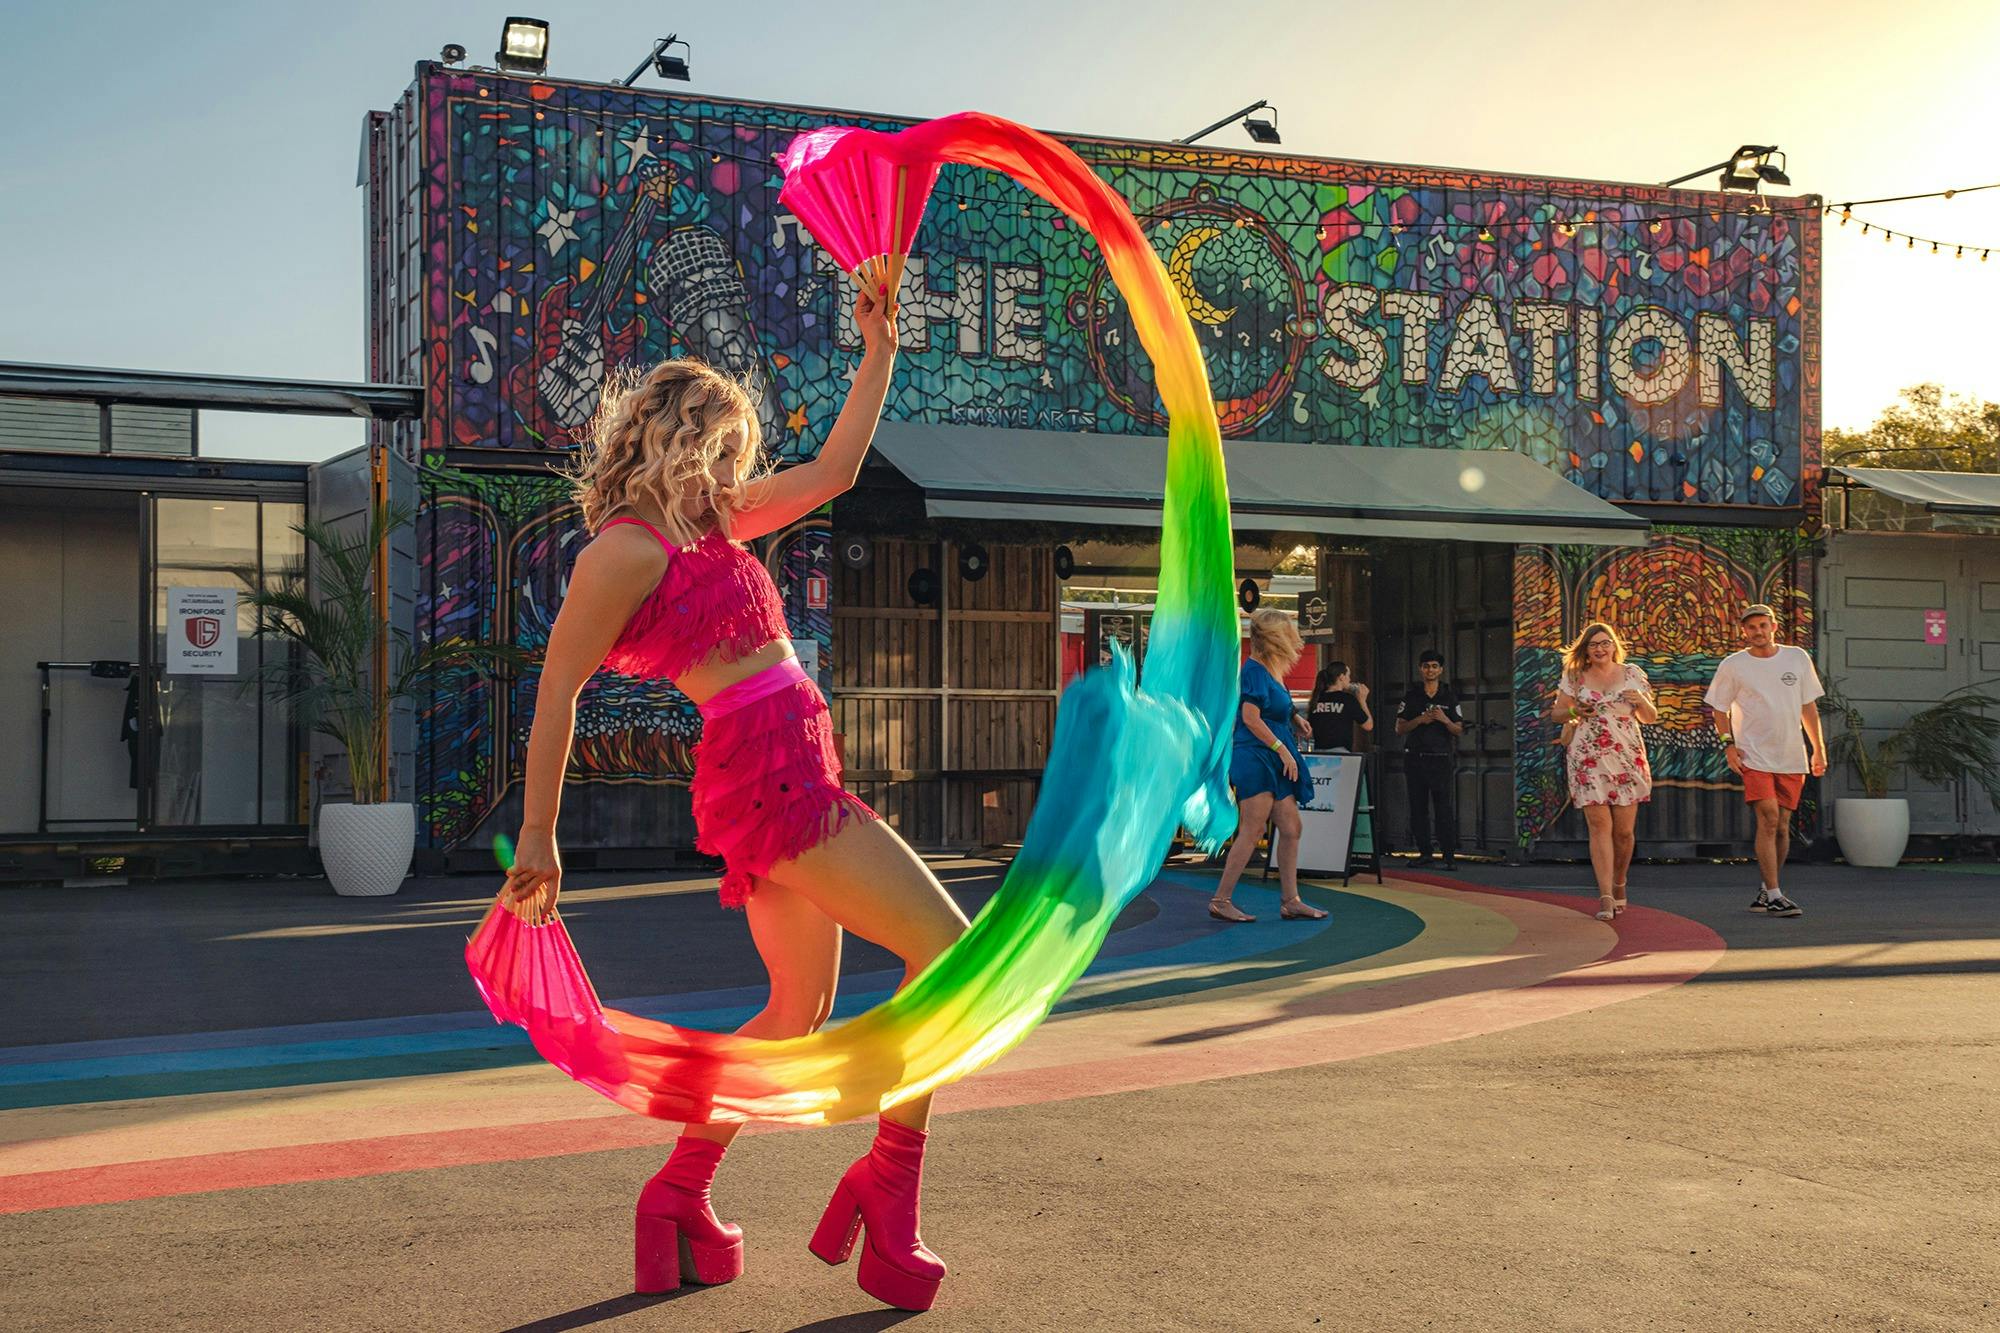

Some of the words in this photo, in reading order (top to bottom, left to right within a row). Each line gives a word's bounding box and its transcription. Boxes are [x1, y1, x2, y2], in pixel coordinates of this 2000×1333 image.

[812, 245, 1045, 364] THE
[1318, 283, 1777, 410] STATION
[1037, 408, 1096, 431] ARTS
[1312, 702, 1345, 713] REW
